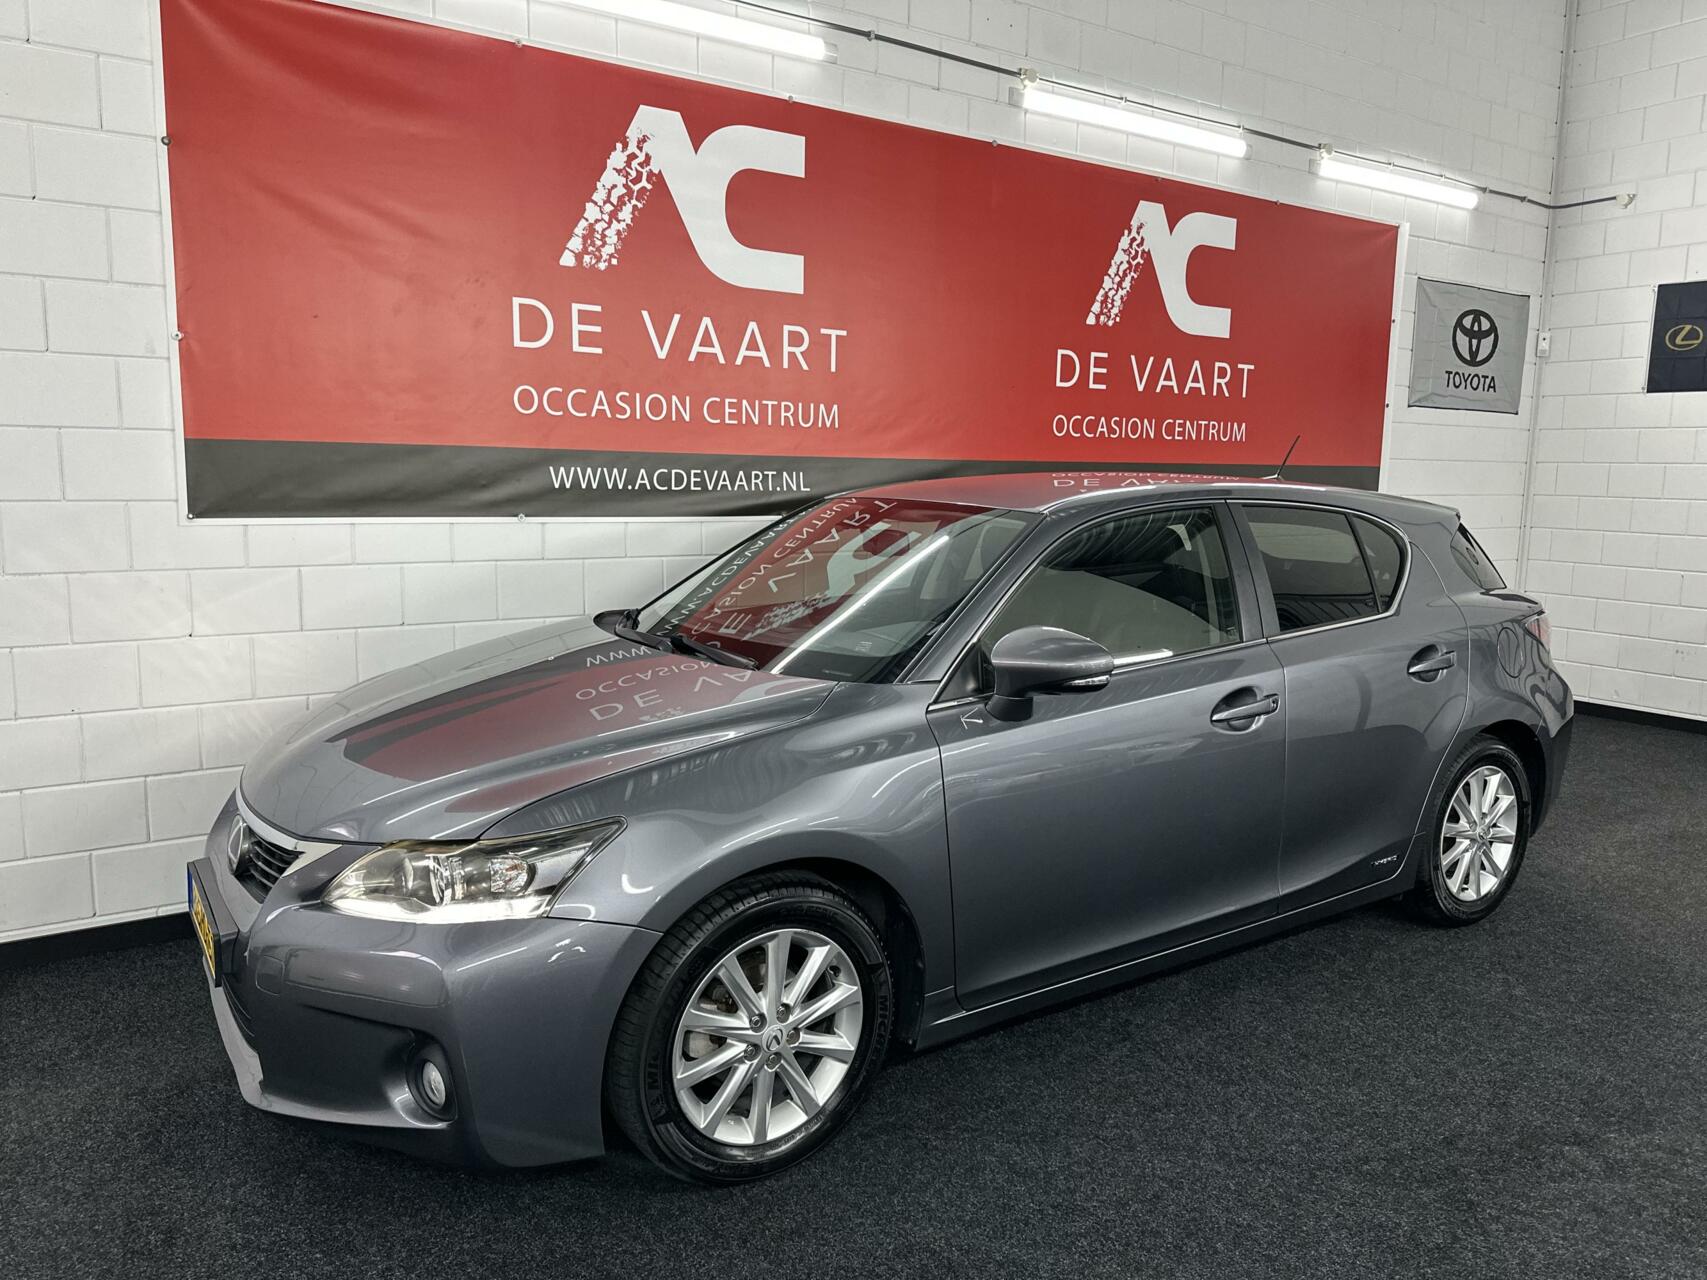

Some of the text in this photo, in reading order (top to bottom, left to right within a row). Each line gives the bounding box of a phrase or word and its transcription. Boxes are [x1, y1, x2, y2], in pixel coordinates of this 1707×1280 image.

[559, 104, 806, 294] AC
[1086, 200, 1237, 338] AC
[512, 297, 847, 372] DE VAART
[1056, 349, 1254, 397] DE VAART
[1445, 370, 1497, 393] TOYOTA
[514, 385, 838, 428] OCCASION CENTRUM
[1053, 415, 1245, 441] OCCASION CENTRUM
[549, 466, 810, 491] WWW.ACDEVAART.NL
